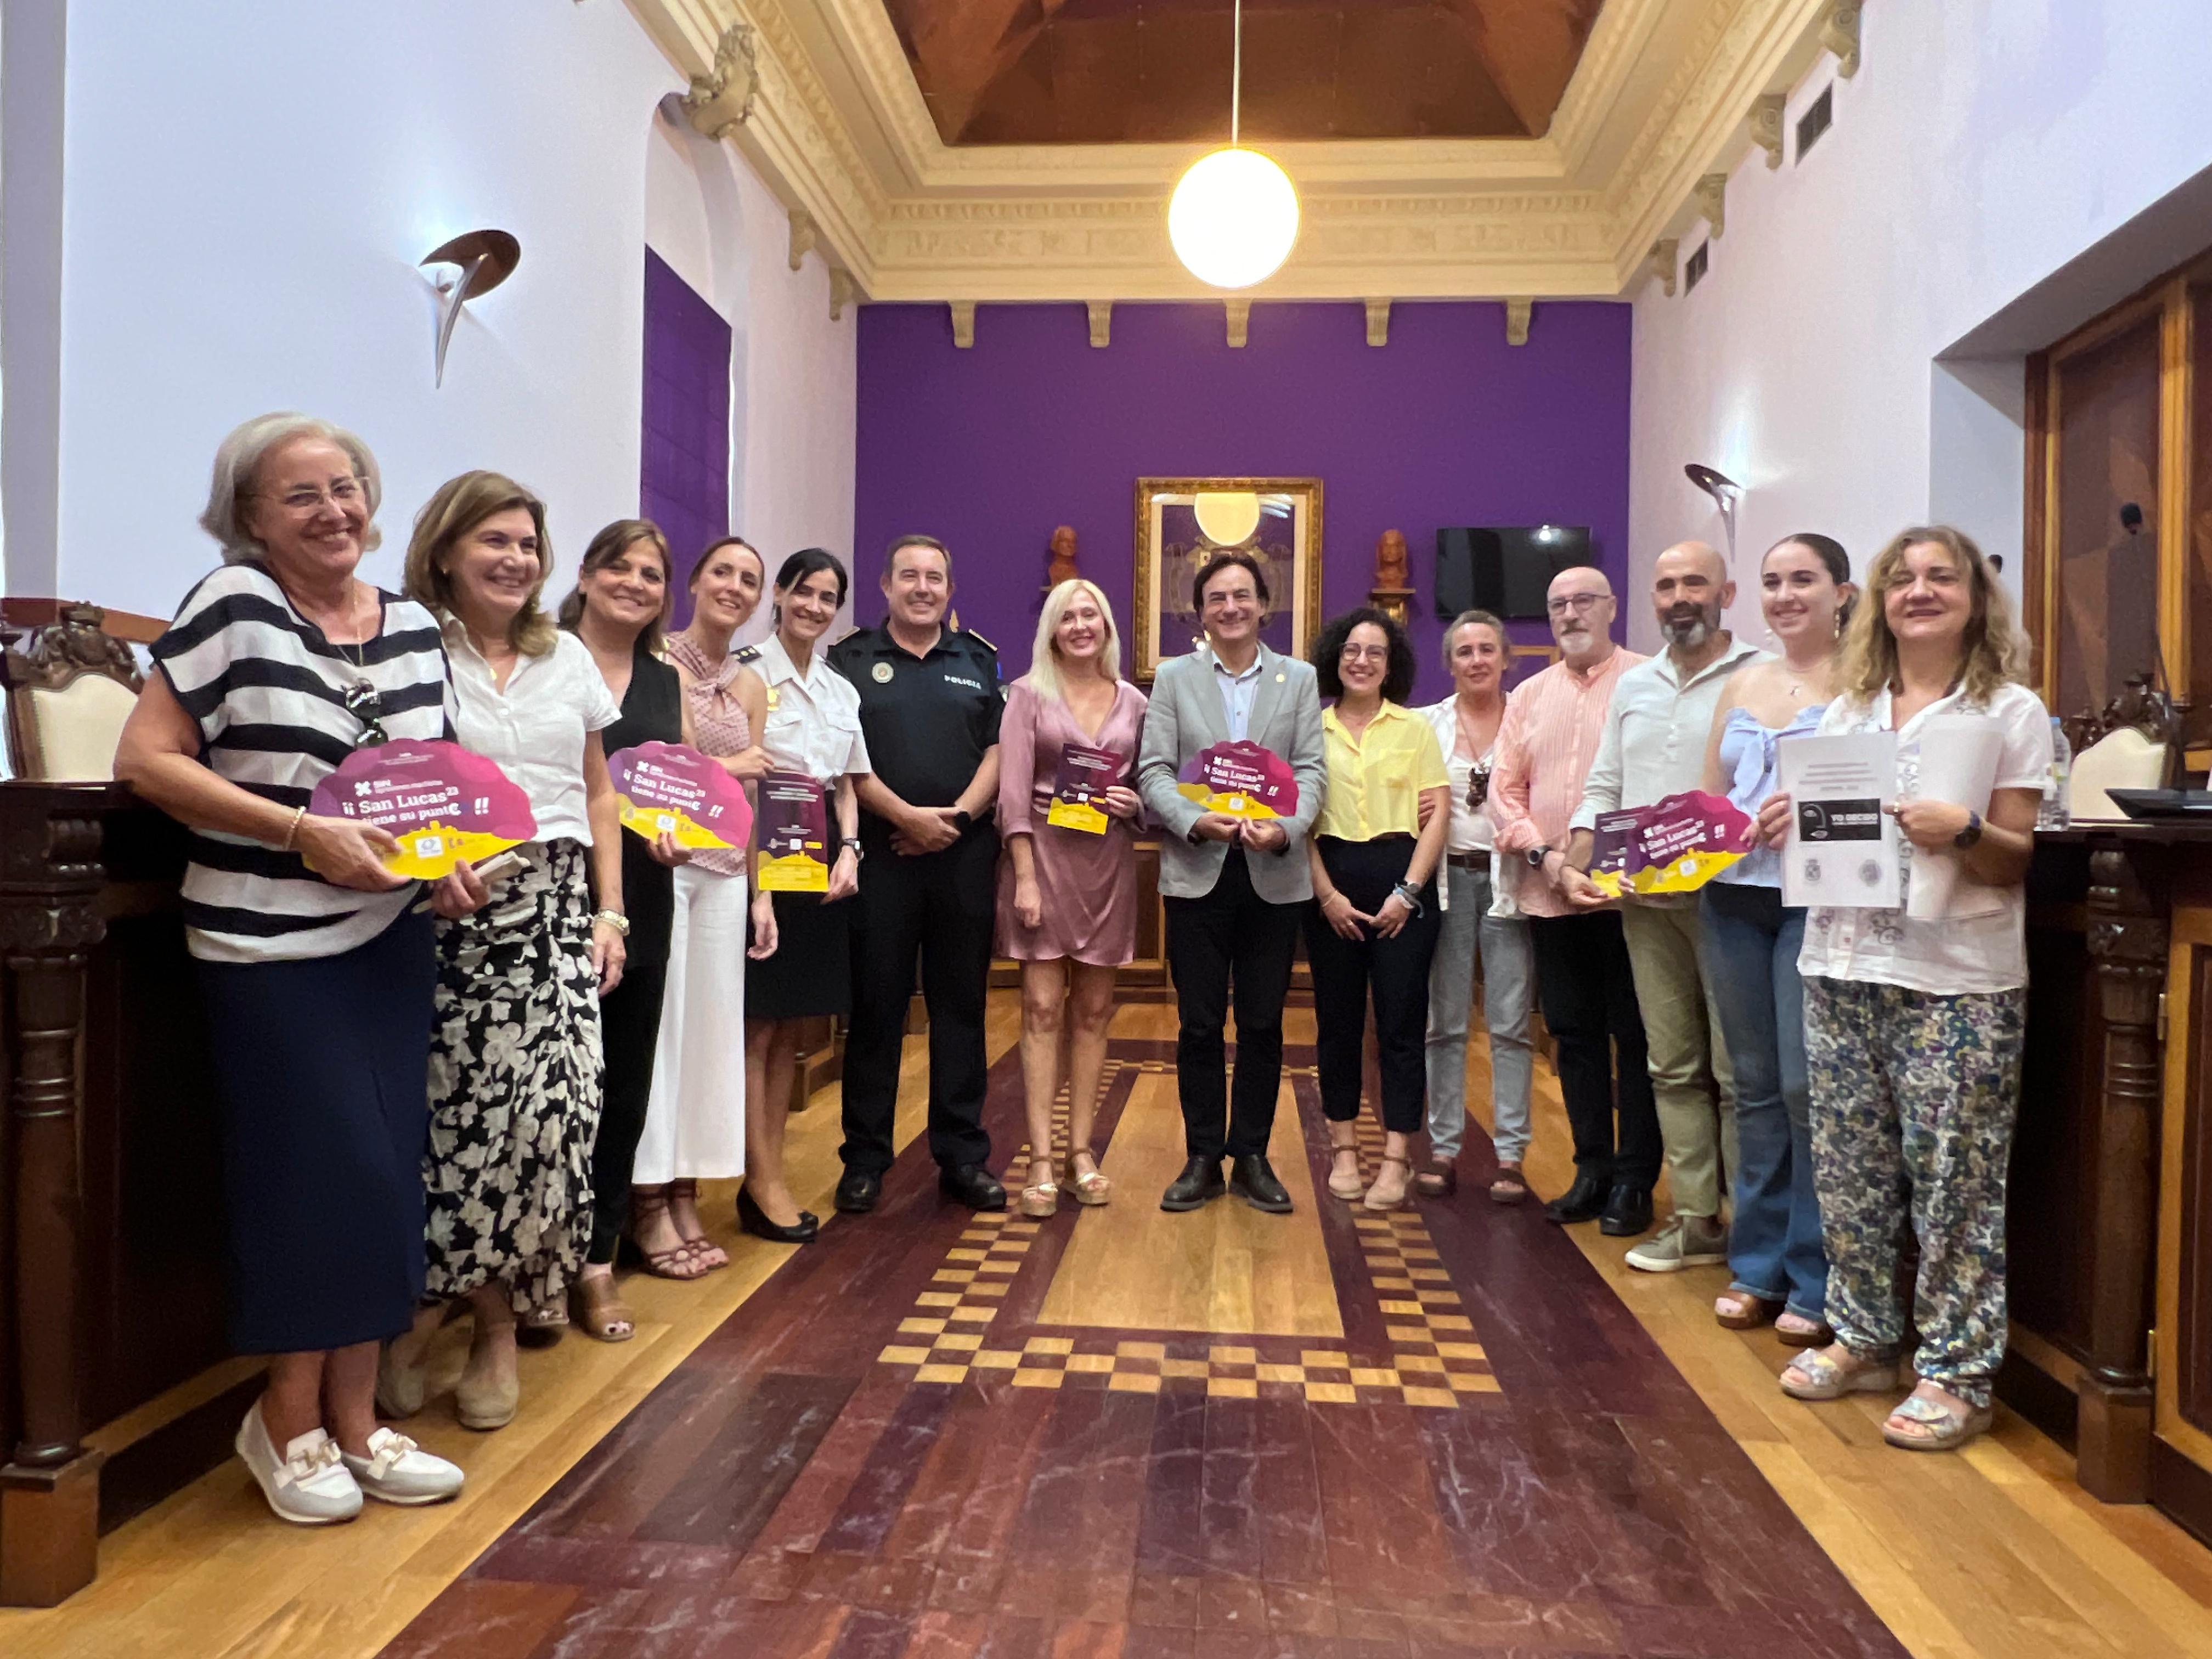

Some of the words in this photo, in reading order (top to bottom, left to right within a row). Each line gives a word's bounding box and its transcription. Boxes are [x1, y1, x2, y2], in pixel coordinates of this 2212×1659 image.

[944, 675, 981, 690] POLICIA
[634, 774, 657, 788] San
[659, 781, 696, 799] Lucas
[359, 799, 394, 814] San
[396, 792, 447, 808] Lucas
[400, 811, 415, 821] su
